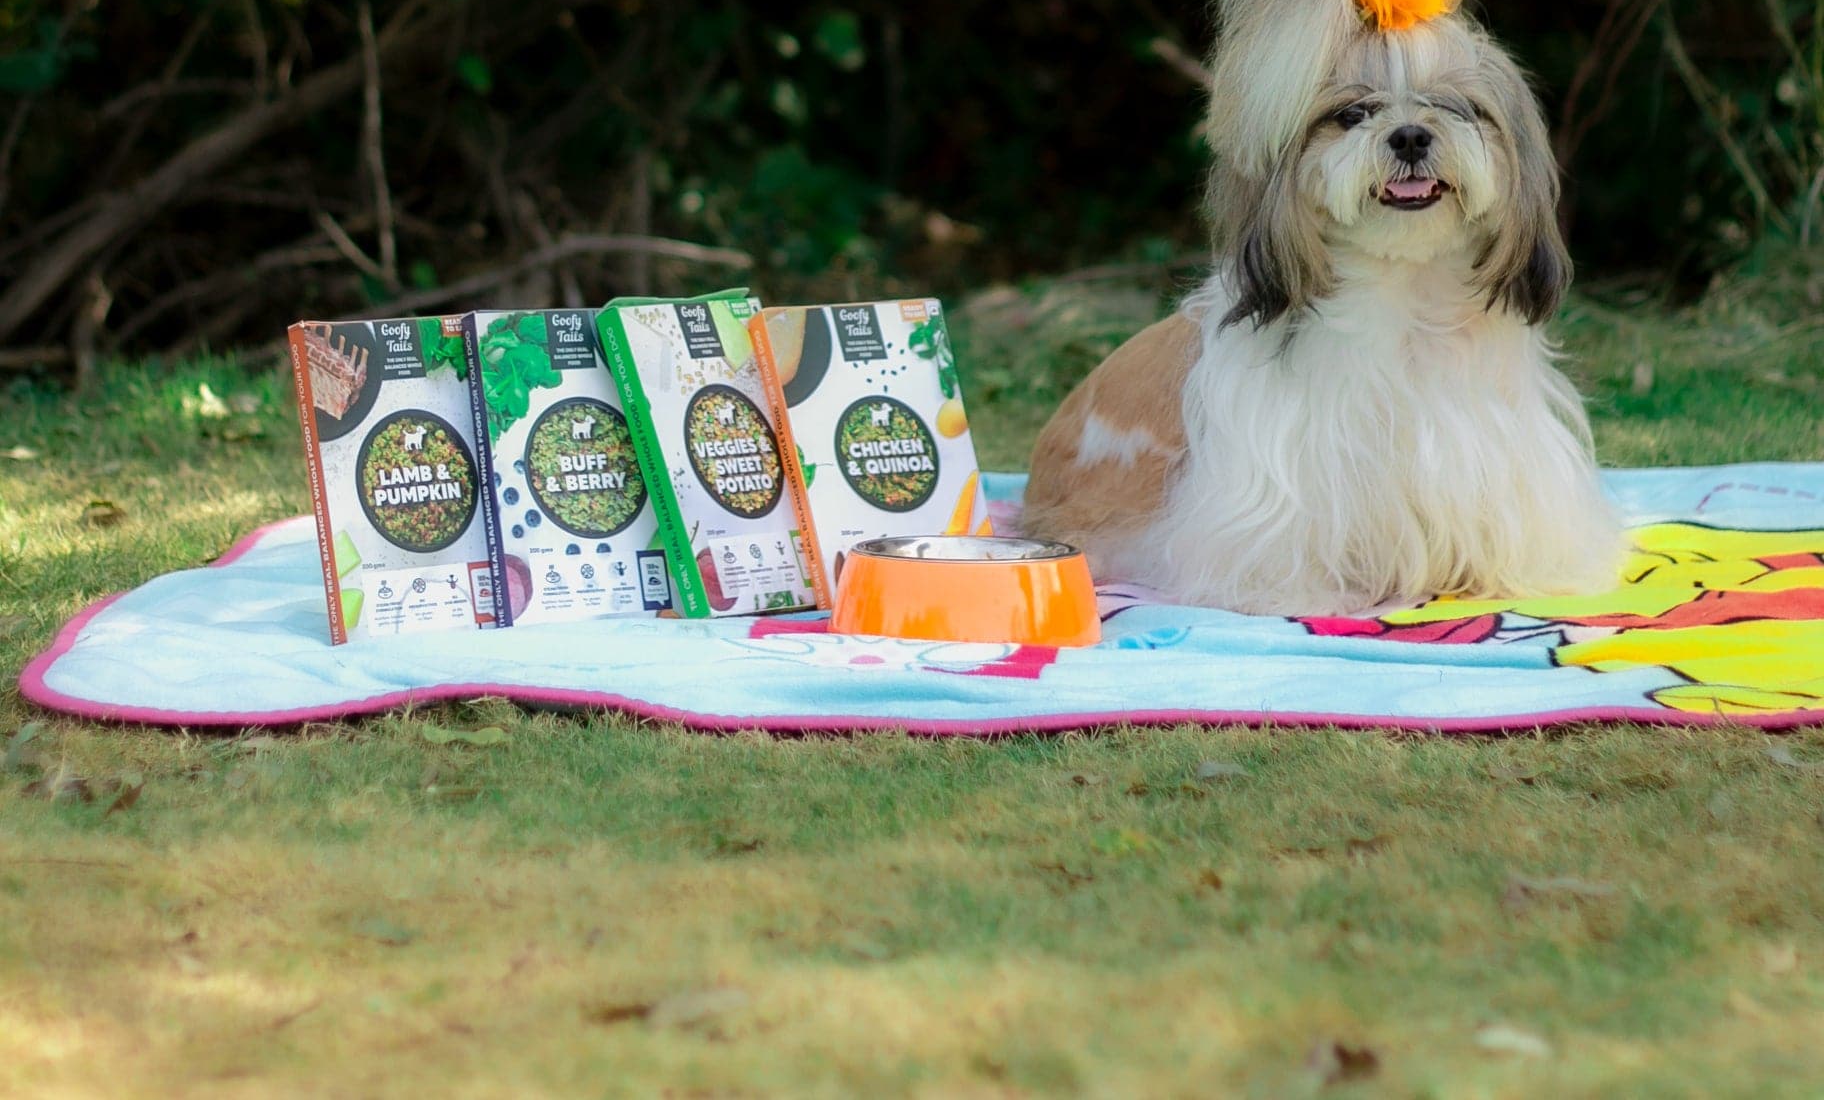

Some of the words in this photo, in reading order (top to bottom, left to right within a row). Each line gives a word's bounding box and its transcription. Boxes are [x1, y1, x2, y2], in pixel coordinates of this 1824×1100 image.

[552, 314, 582, 330] Goofy
[681, 305, 706, 321] Goofy
[839, 309, 869, 324] Goofy
[381, 322, 411, 340] Goofy
[557, 330, 584, 343] Tails
[687, 321, 710, 333] Tails
[845, 324, 872, 336] Tails
[386, 340, 413, 352] Tails
[606, 326, 618, 351] DOG
[291, 344, 300, 370] DOG
[615, 354, 627, 381] YOUR
[468, 358, 477, 387] YOUR
[296, 372, 306, 402] YOUR
[624, 383, 634, 403] FOR
[301, 403, 309, 424] FOR
[630, 404, 643, 434] FOOD
[475, 412, 484, 443] FOOD
[304, 426, 314, 458] FOOD
[694, 438, 758, 458] VEGGIES
[758, 436, 772, 452] &
[849, 438, 924, 458] CHICKEN
[479, 444, 487, 484] WHOLE
[560, 454, 607, 472] BUFF
[716, 456, 762, 475] SWEET
[848, 460, 863, 476] &
[865, 455, 935, 474] QUINOA
[309, 460, 320, 500] WHOLE
[379, 465, 432, 486] LAMB
[436, 464, 452, 480] &
[546, 476, 562, 492] &
[565, 472, 626, 491] BERRY
[715, 474, 773, 494] POTATO
[374, 482, 461, 506] PUMPKIN
[483, 486, 495, 545] BALANCED
[316, 502, 329, 561] BALANCED
[679, 563, 691, 590] ONLY
[494, 580, 502, 606] ONLY
[687, 593, 697, 612] THE
[329, 596, 338, 624] ONLY
[332, 626, 340, 645] THE
